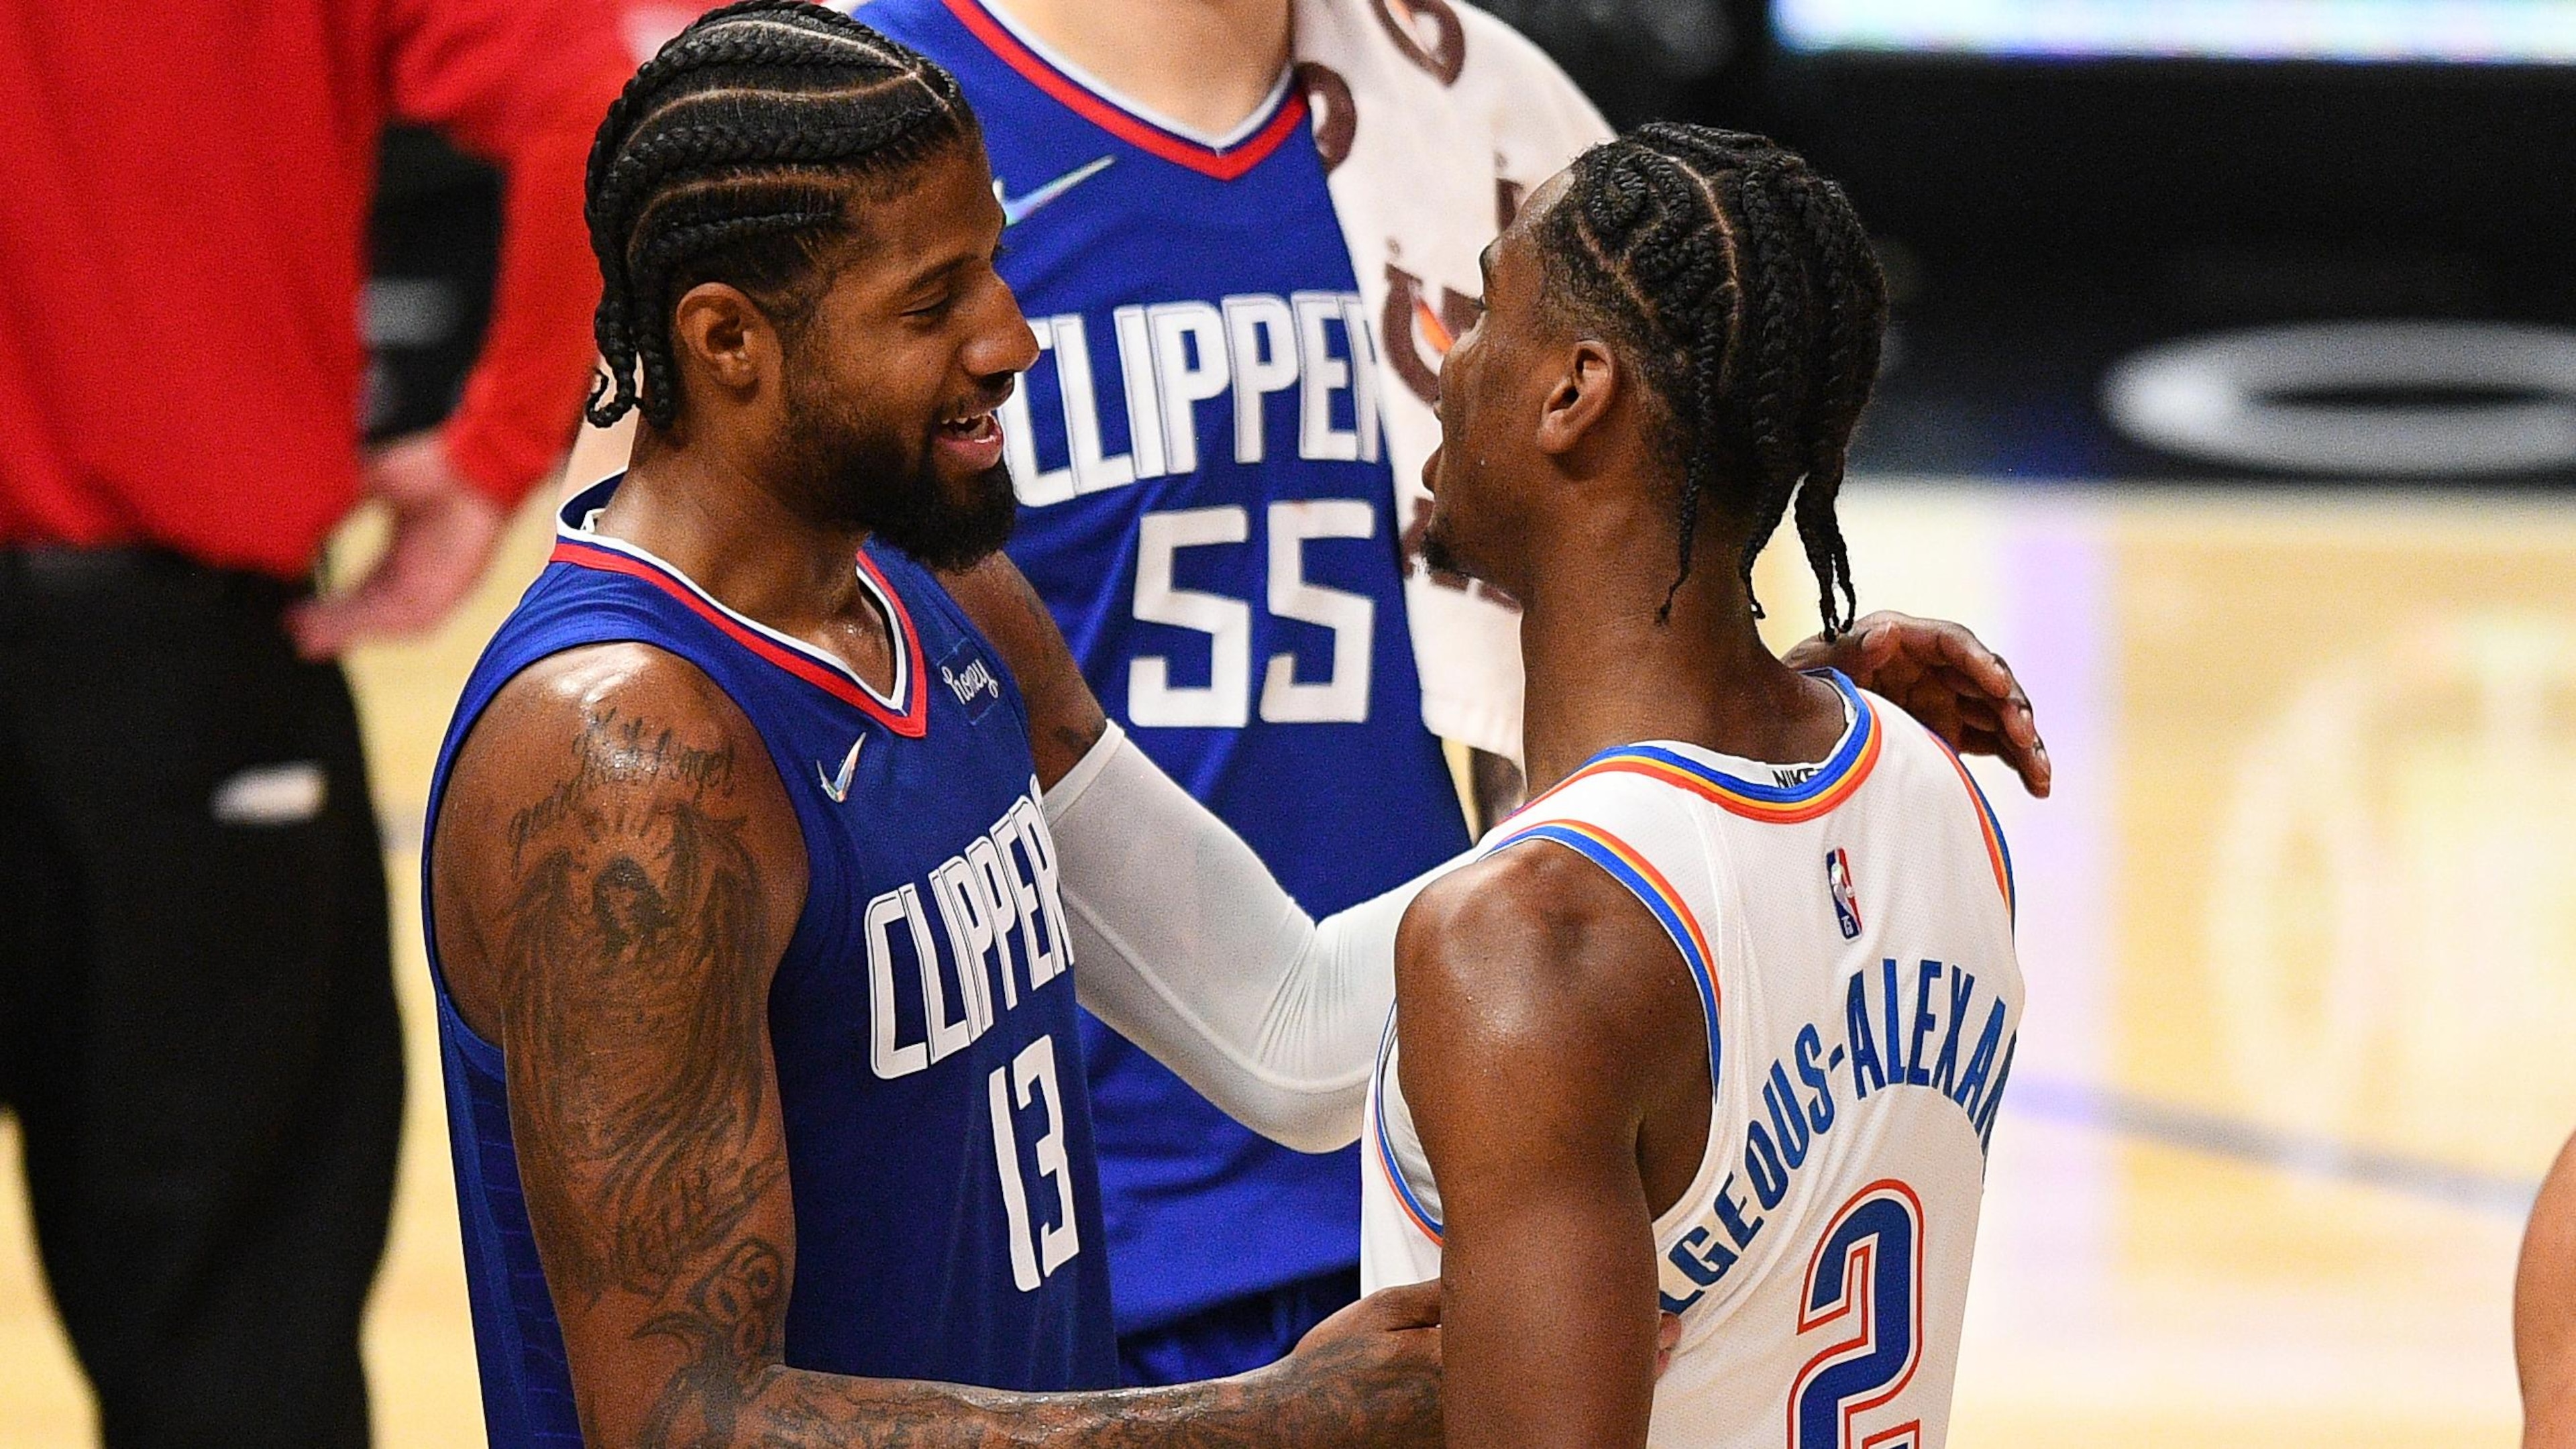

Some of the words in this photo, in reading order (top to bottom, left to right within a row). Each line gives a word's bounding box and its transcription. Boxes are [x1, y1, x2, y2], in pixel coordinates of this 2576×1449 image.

[941, 659, 998, 705] honey
[1128, 499, 1374, 728] 55
[989, 1034, 1079, 1292] 13
[1786, 1179, 1924, 1449] 2
